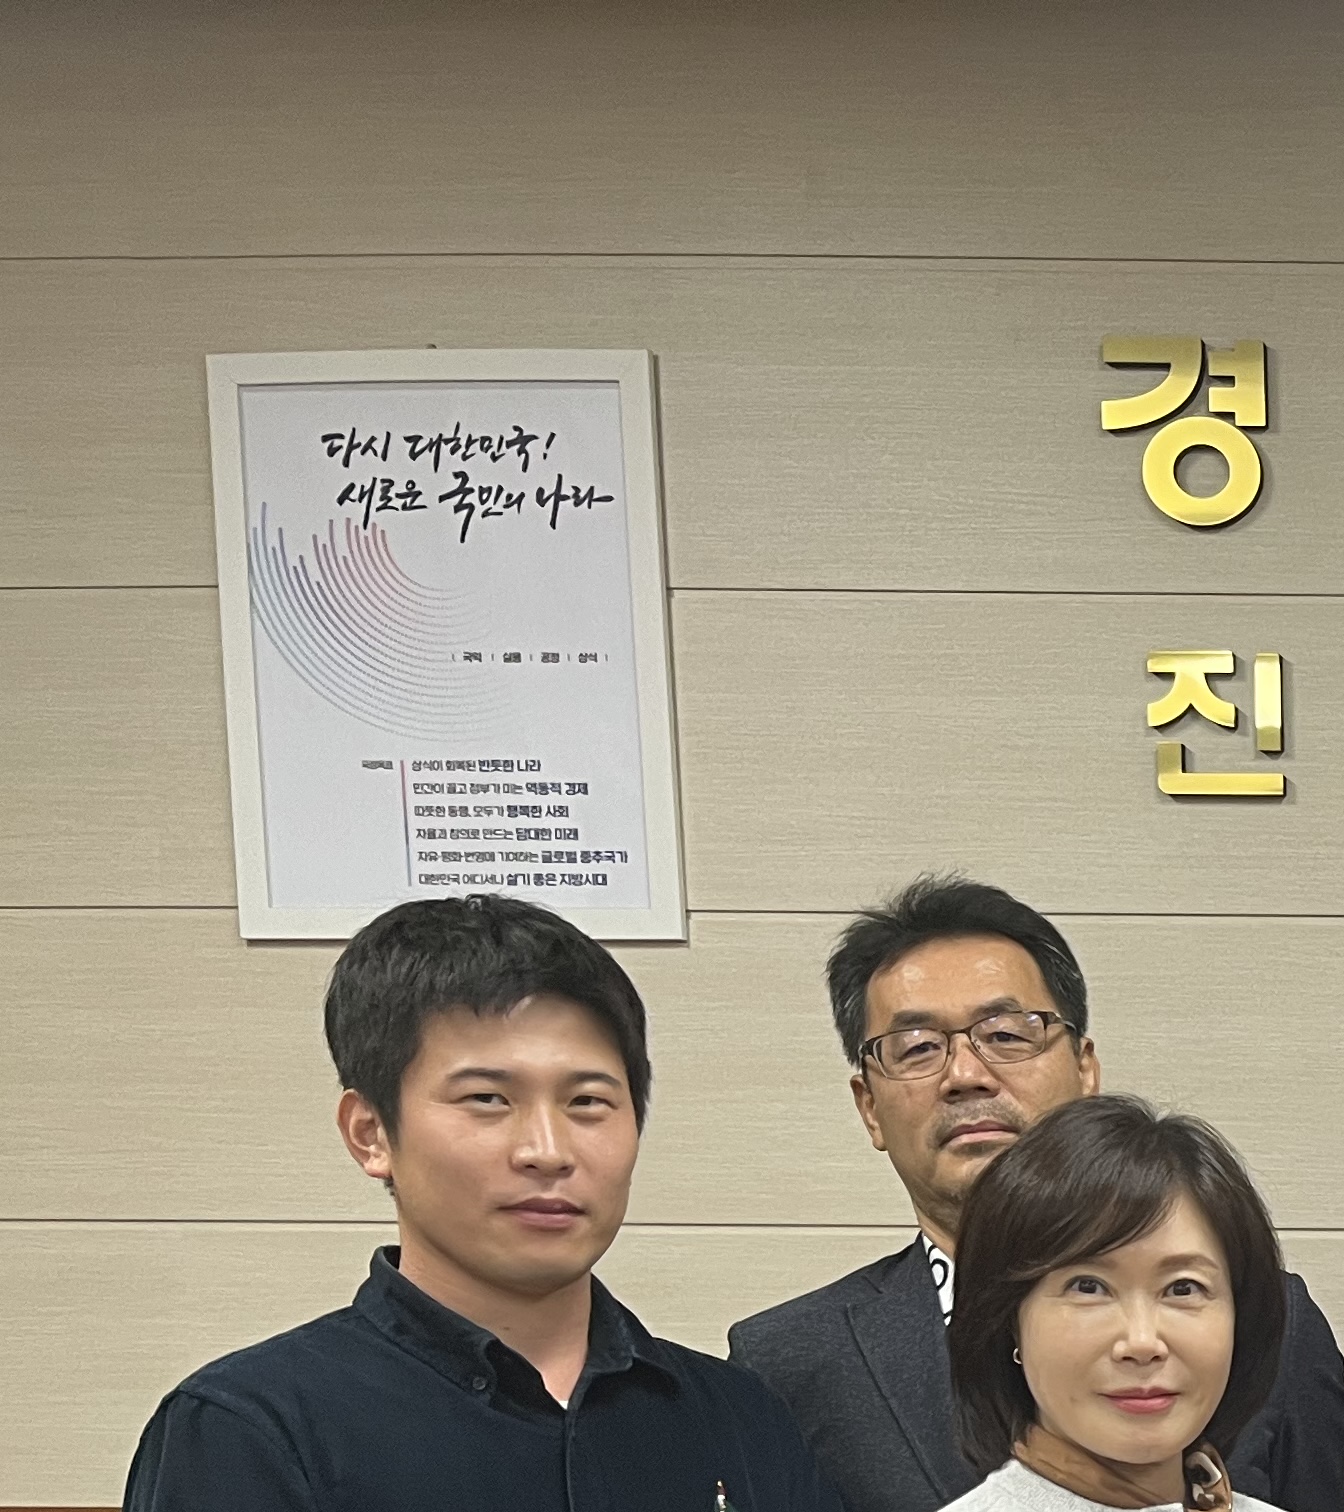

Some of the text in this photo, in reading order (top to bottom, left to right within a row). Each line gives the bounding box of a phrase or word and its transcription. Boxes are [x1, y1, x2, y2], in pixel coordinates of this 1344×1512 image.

[320, 421, 557, 474] 다시 대한민국!
[336, 470, 615, 544] 새로운 국민의 나라
[411, 760, 443, 772] 상식이
[478, 759, 514, 772] 반듯한
[517, 759, 541, 772] 나라
[413, 783, 444, 795] 민간이
[525, 782, 562, 795] 역동적
[564, 782, 589, 796] 경제
[414, 805, 446, 818] 따뜻한
[473, 805, 505, 818] 모두가
[506, 805, 542, 818] 행복한
[545, 805, 570, 818] 사회
[416, 828, 447, 841] 자율과
[482, 828, 514, 841] 만드는
[515, 827, 551, 841] 담대한
[554, 828, 579, 841] 미래
[497, 851, 540, 864] 기여하는
[541, 851, 578, 864] 글로벌
[580, 851, 629, 864] 중추국가
[418, 873, 608, 887] 대한민국 어디서나 살기 좋은 지방시대
